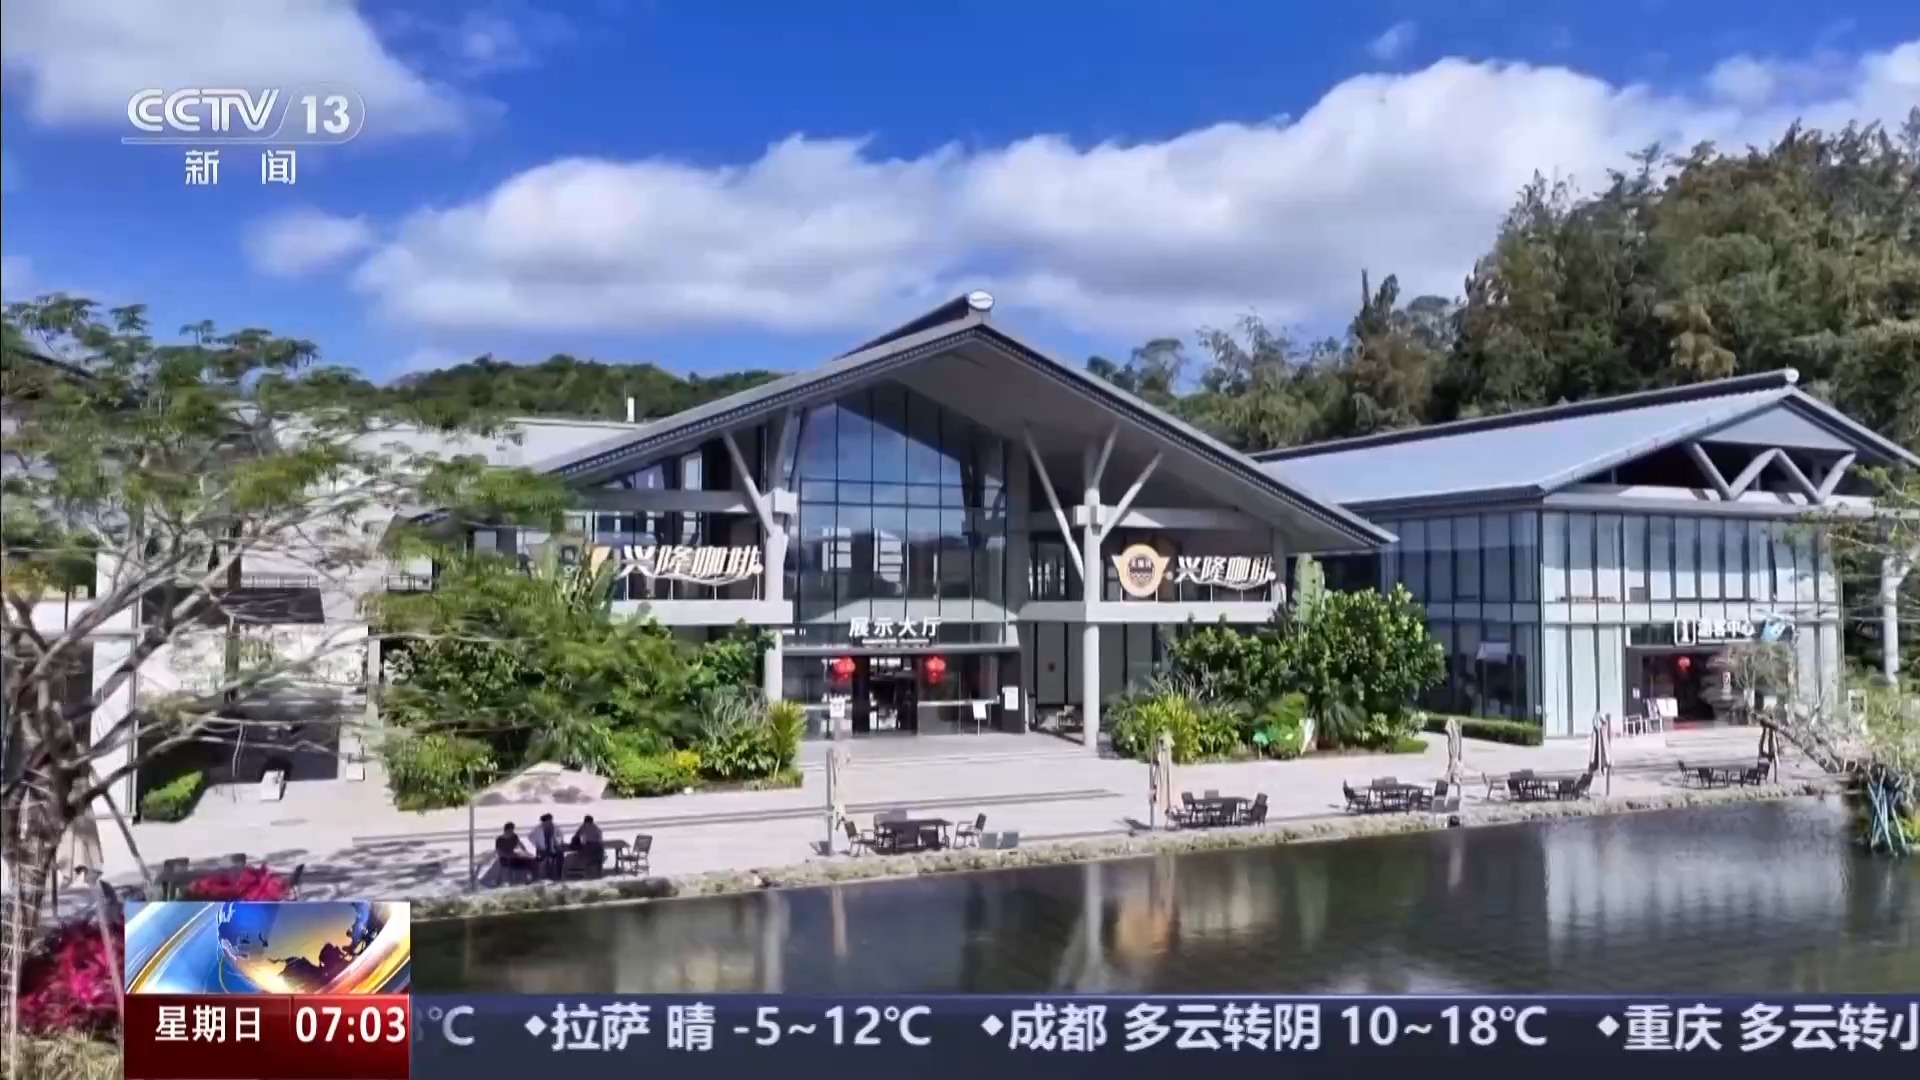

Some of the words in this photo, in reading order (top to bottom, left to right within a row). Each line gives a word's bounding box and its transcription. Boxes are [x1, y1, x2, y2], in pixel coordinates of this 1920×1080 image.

[618, 545, 764, 586] 兴隆咖啡
[1174, 556, 1277, 590] 兴隆咖啡
[848, 616, 941, 638] 展示大厅
